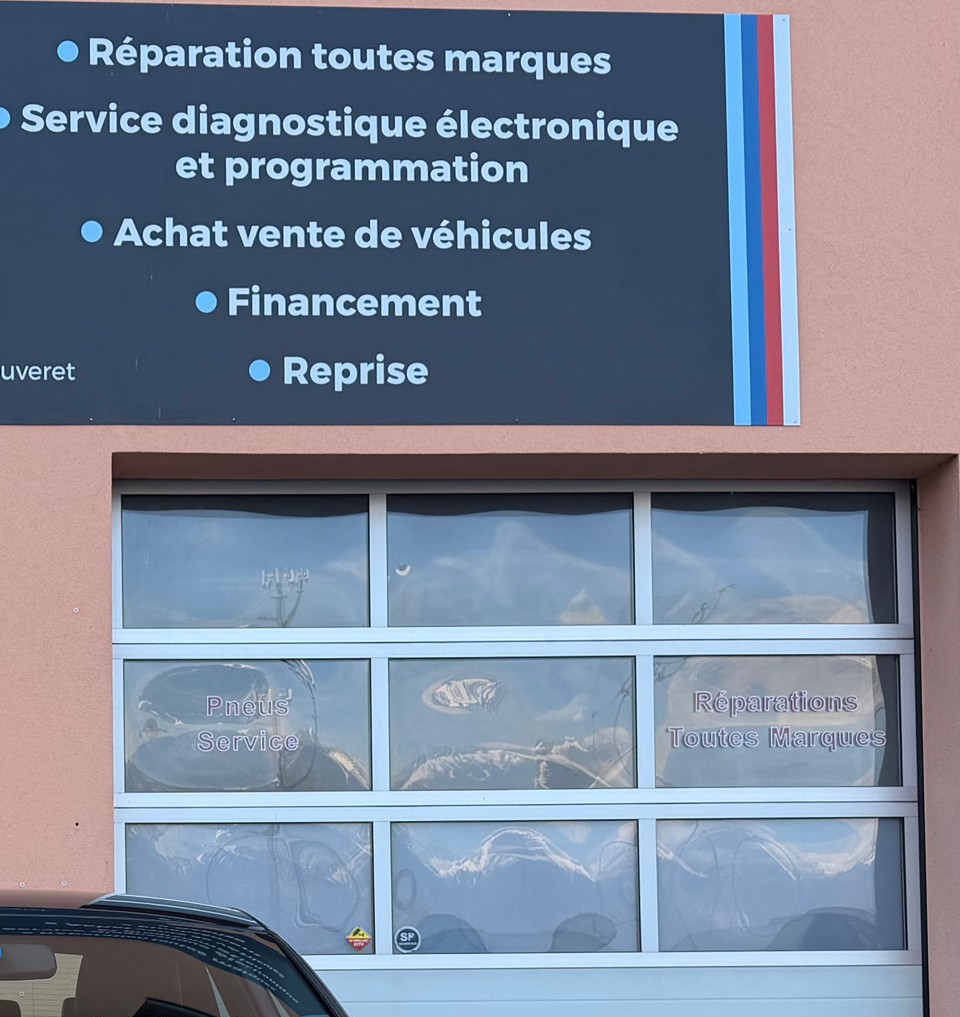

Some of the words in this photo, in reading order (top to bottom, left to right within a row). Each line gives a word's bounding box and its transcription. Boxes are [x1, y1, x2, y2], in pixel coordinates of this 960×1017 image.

[90, 36, 301, 73] Réparation
[312, 44, 434, 71] toutes
[445, 50, 611, 80] marques
[21, 103, 162, 133] Service
[172, 104, 426, 144] diagnostique
[436, 109, 678, 147] électronique
[176, 153, 214, 179] et
[226, 152, 528, 187] programmation
[114, 217, 228, 247] Achat
[237, 222, 345, 248] vente
[355, 220, 402, 248] de
[411, 219, 591, 250] véhicules
[229, 285, 481, 316] Financement
[284, 354, 428, 391] Reprise
[206, 695, 290, 717] Pneus
[693, 690, 859, 717] Réparations
[197, 731, 300, 752] Service
[667, 727, 759, 749] Toutes
[768, 726, 887, 752] Marques
